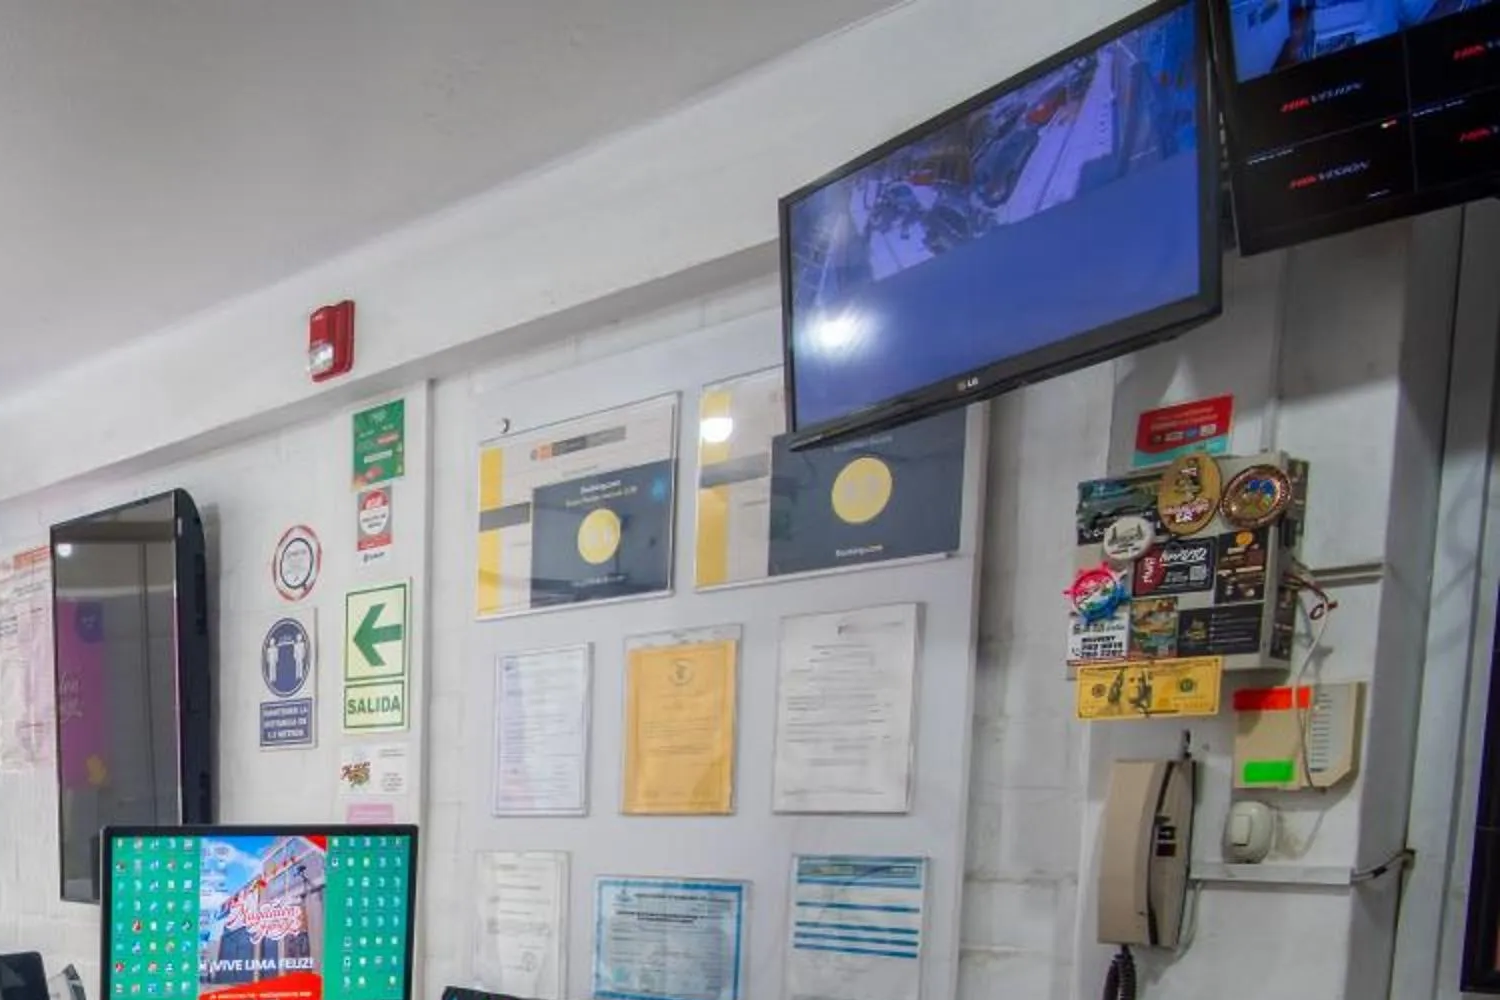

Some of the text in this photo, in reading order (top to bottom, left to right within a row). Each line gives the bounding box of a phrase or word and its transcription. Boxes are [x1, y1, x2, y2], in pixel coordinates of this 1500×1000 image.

[348, 695, 401, 716] SALIDA
[245, 959, 276, 971] LIMA
[280, 957, 314, 969] FELIZ!
